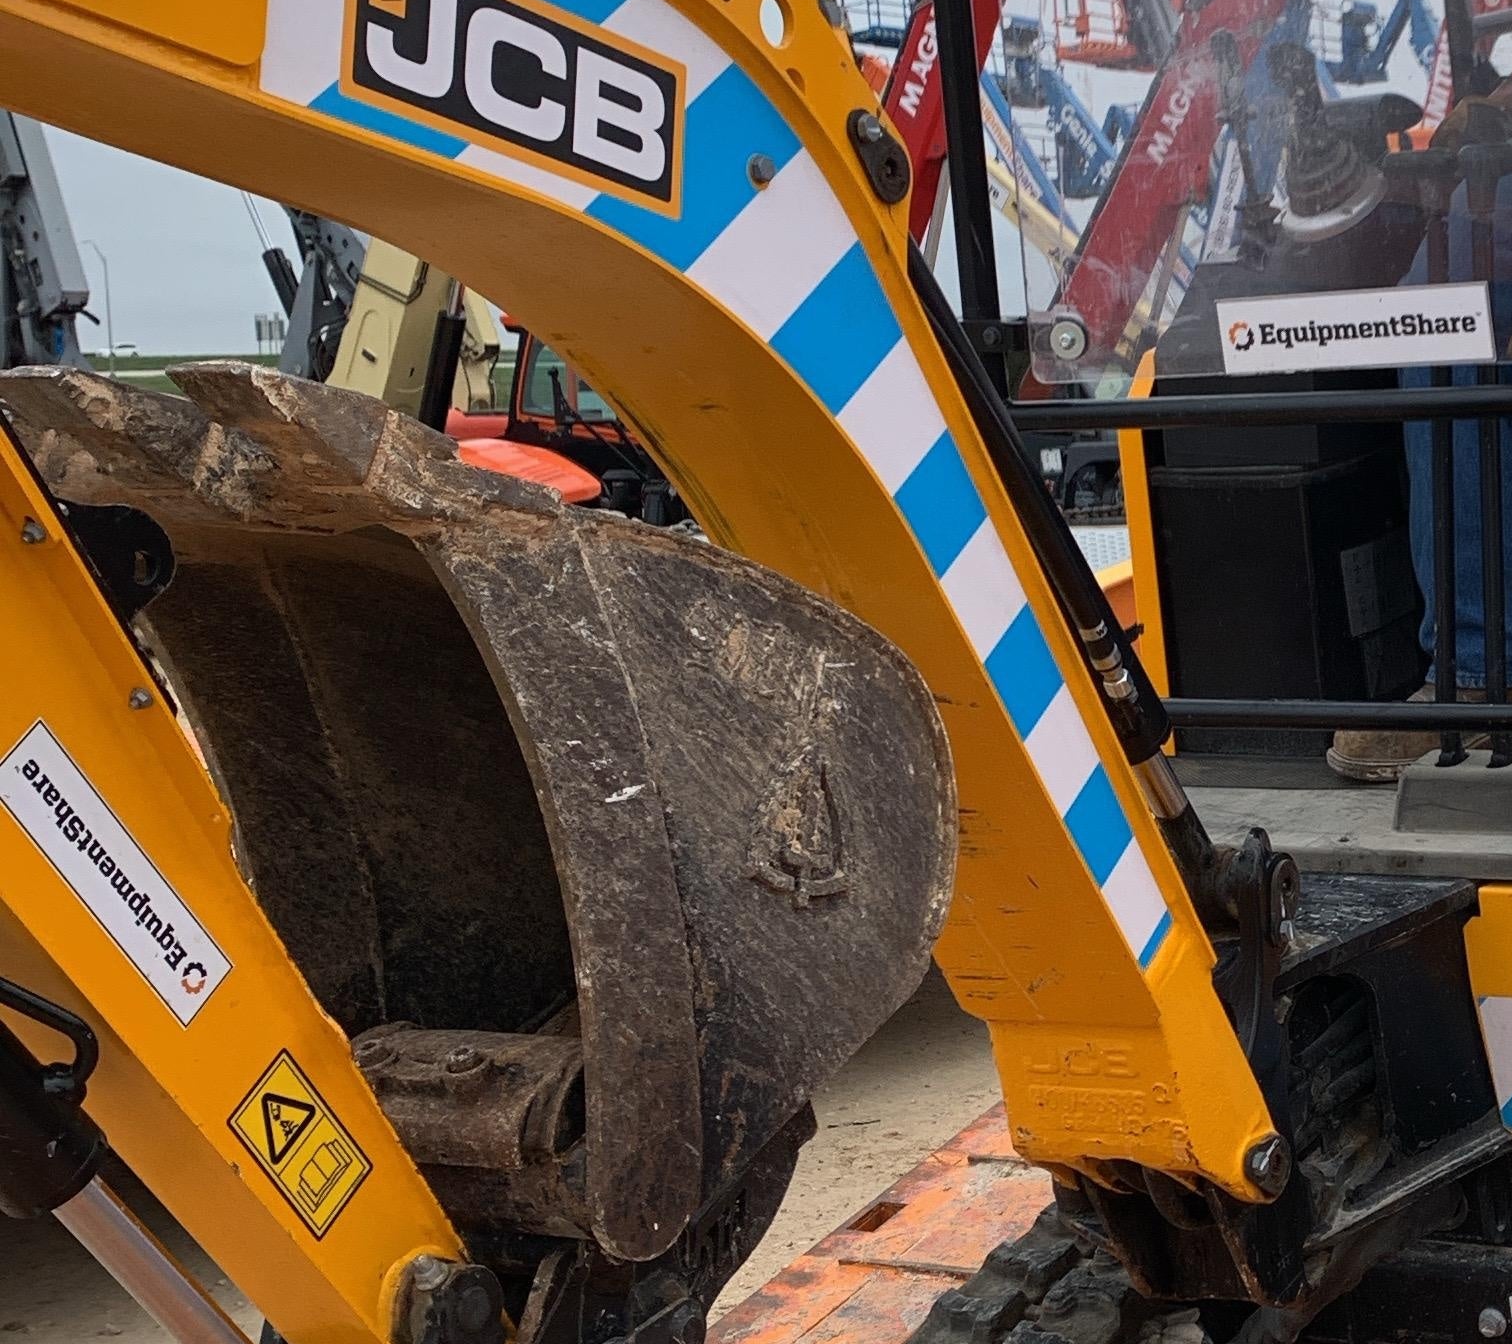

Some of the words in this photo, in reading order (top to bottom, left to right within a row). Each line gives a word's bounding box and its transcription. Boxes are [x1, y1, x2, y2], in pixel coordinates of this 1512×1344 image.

[898, 6, 938, 118] MAG
[1258, 313, 1477, 348] EquipmentShare
[21, 758, 189, 972] EquipmentShare
